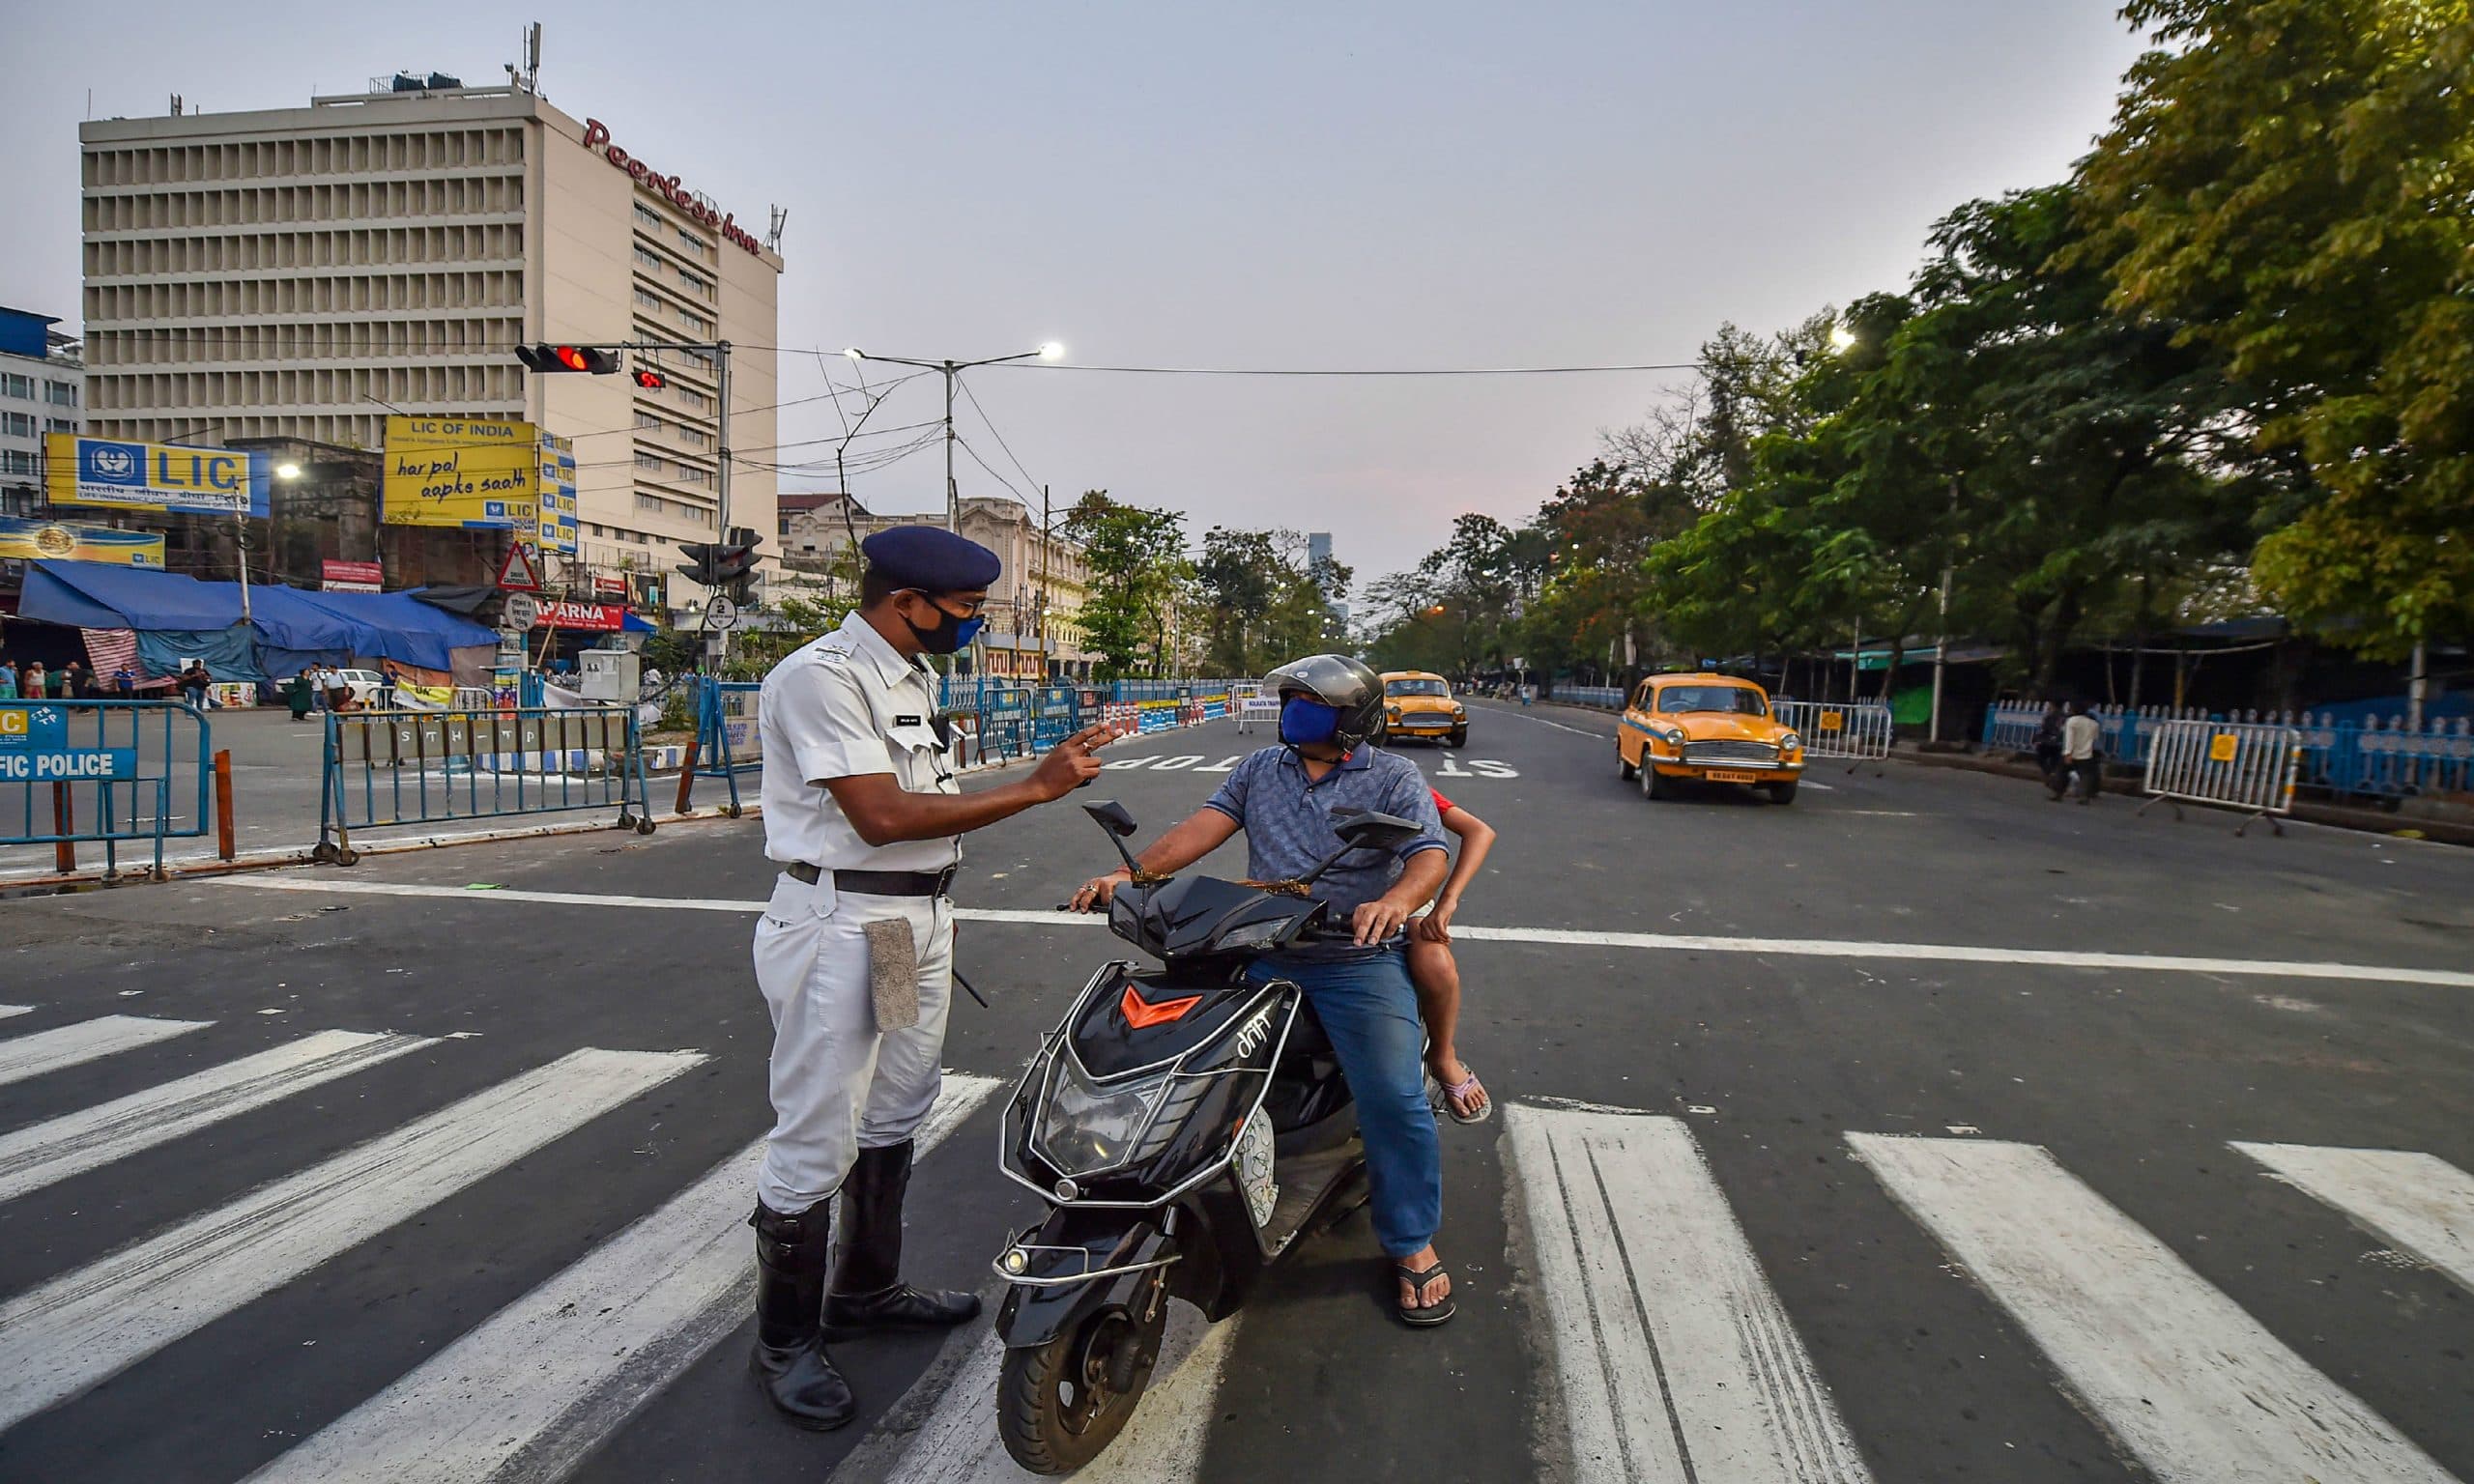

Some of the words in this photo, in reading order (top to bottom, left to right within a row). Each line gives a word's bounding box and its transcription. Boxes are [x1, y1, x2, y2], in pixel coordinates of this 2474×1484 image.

[584, 118, 721, 228] Peerless
[722, 213, 761, 255] Inn
[411, 421, 438, 434] LIC
[442, 423, 464, 435] OF
[470, 424, 514, 438] INDIA
[555, 438, 572, 451] LIC
[158, 452, 236, 489] LIC
[397, 456, 425, 476] har
[428, 451, 458, 481] pal
[557, 468, 573, 481] LIC
[420, 471, 474, 504] aapke
[480, 469, 526, 491] saath
[507, 503, 531, 517] LIC
[557, 498, 573, 511] LIC
[557, 527, 573, 541] LIC
[717, 605, 725, 614] 2
[0, 755, 29, 778] IC
[37, 754, 114, 777] POLICE
